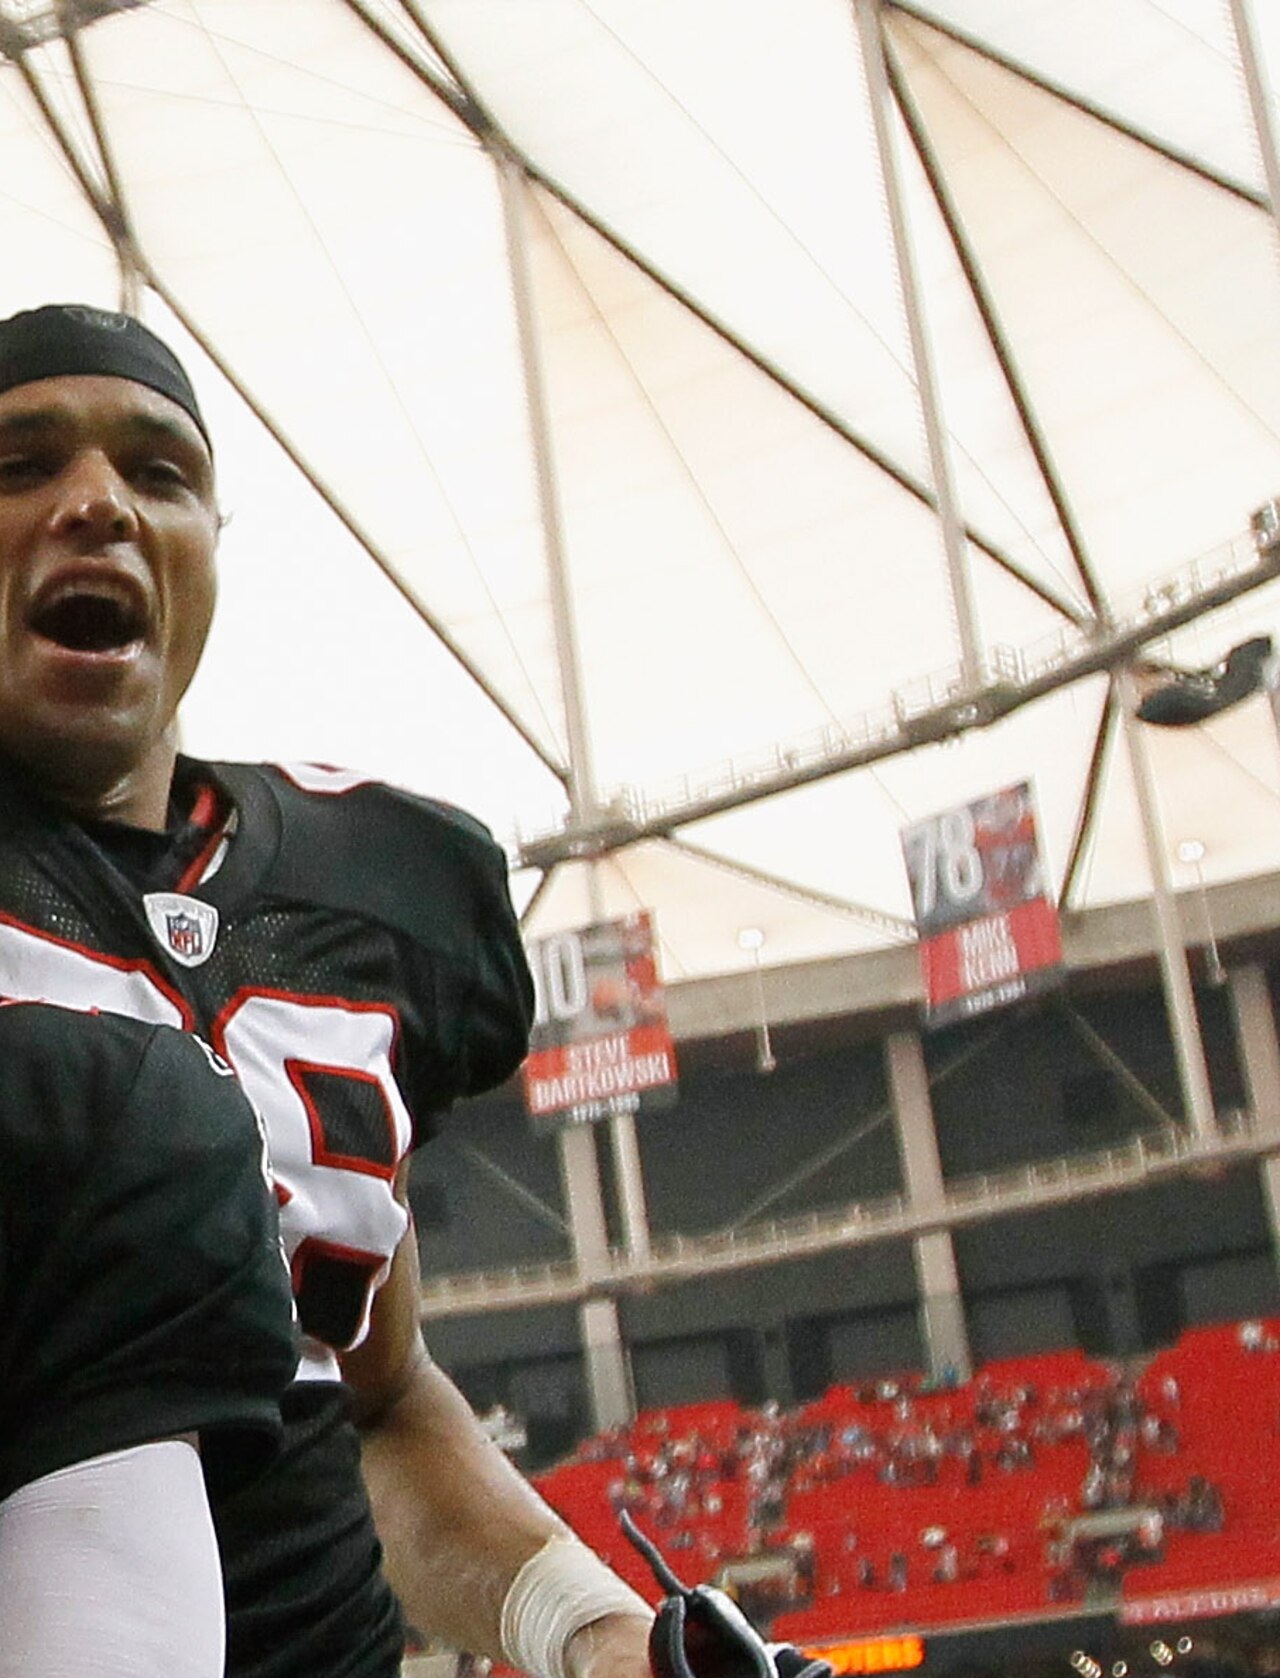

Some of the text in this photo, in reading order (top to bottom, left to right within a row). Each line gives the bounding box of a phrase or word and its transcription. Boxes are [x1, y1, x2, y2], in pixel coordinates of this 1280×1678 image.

[907, 810, 985, 919] 78
[171, 928, 203, 956] NFL
[960, 913, 1014, 953] MIKE
[570, 1032, 630, 1073] STEVE
